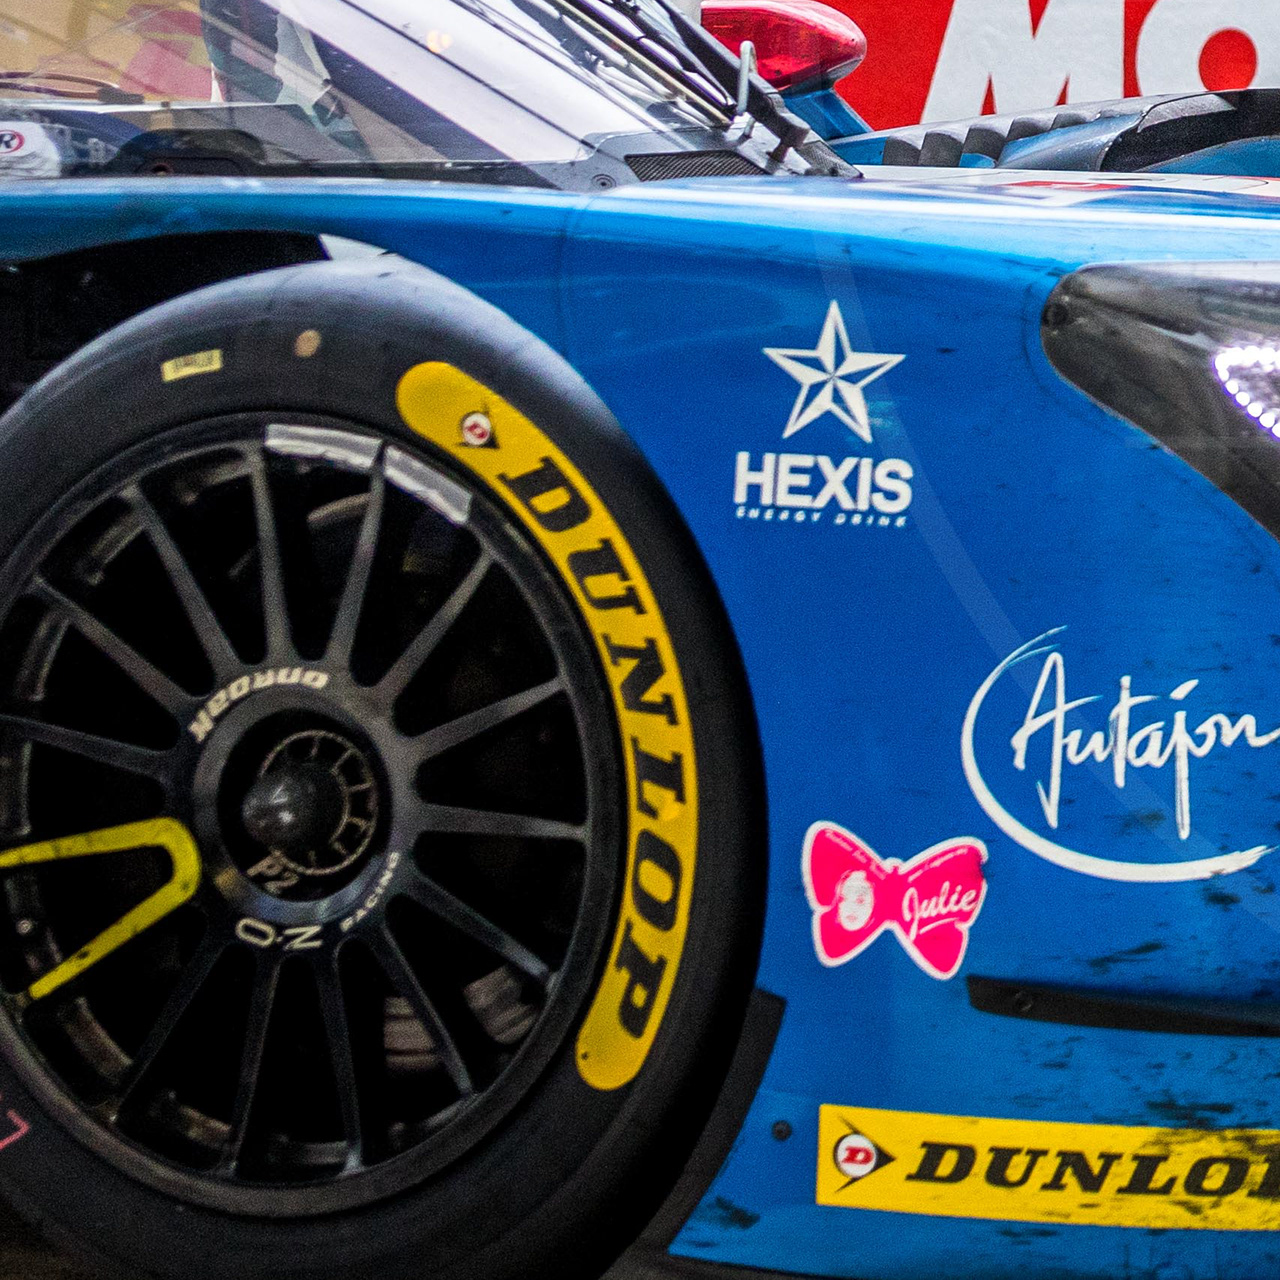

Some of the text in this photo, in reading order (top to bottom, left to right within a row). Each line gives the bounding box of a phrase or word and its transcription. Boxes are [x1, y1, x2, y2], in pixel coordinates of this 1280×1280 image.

[733, 450, 914, 514] HEXIS
[734, 505, 908, 528] ENERGY DRINK
[496, 455, 688, 1042] DUNLOP
[340, 851, 400, 933] RACING
[902, 880, 978, 943] Julie
